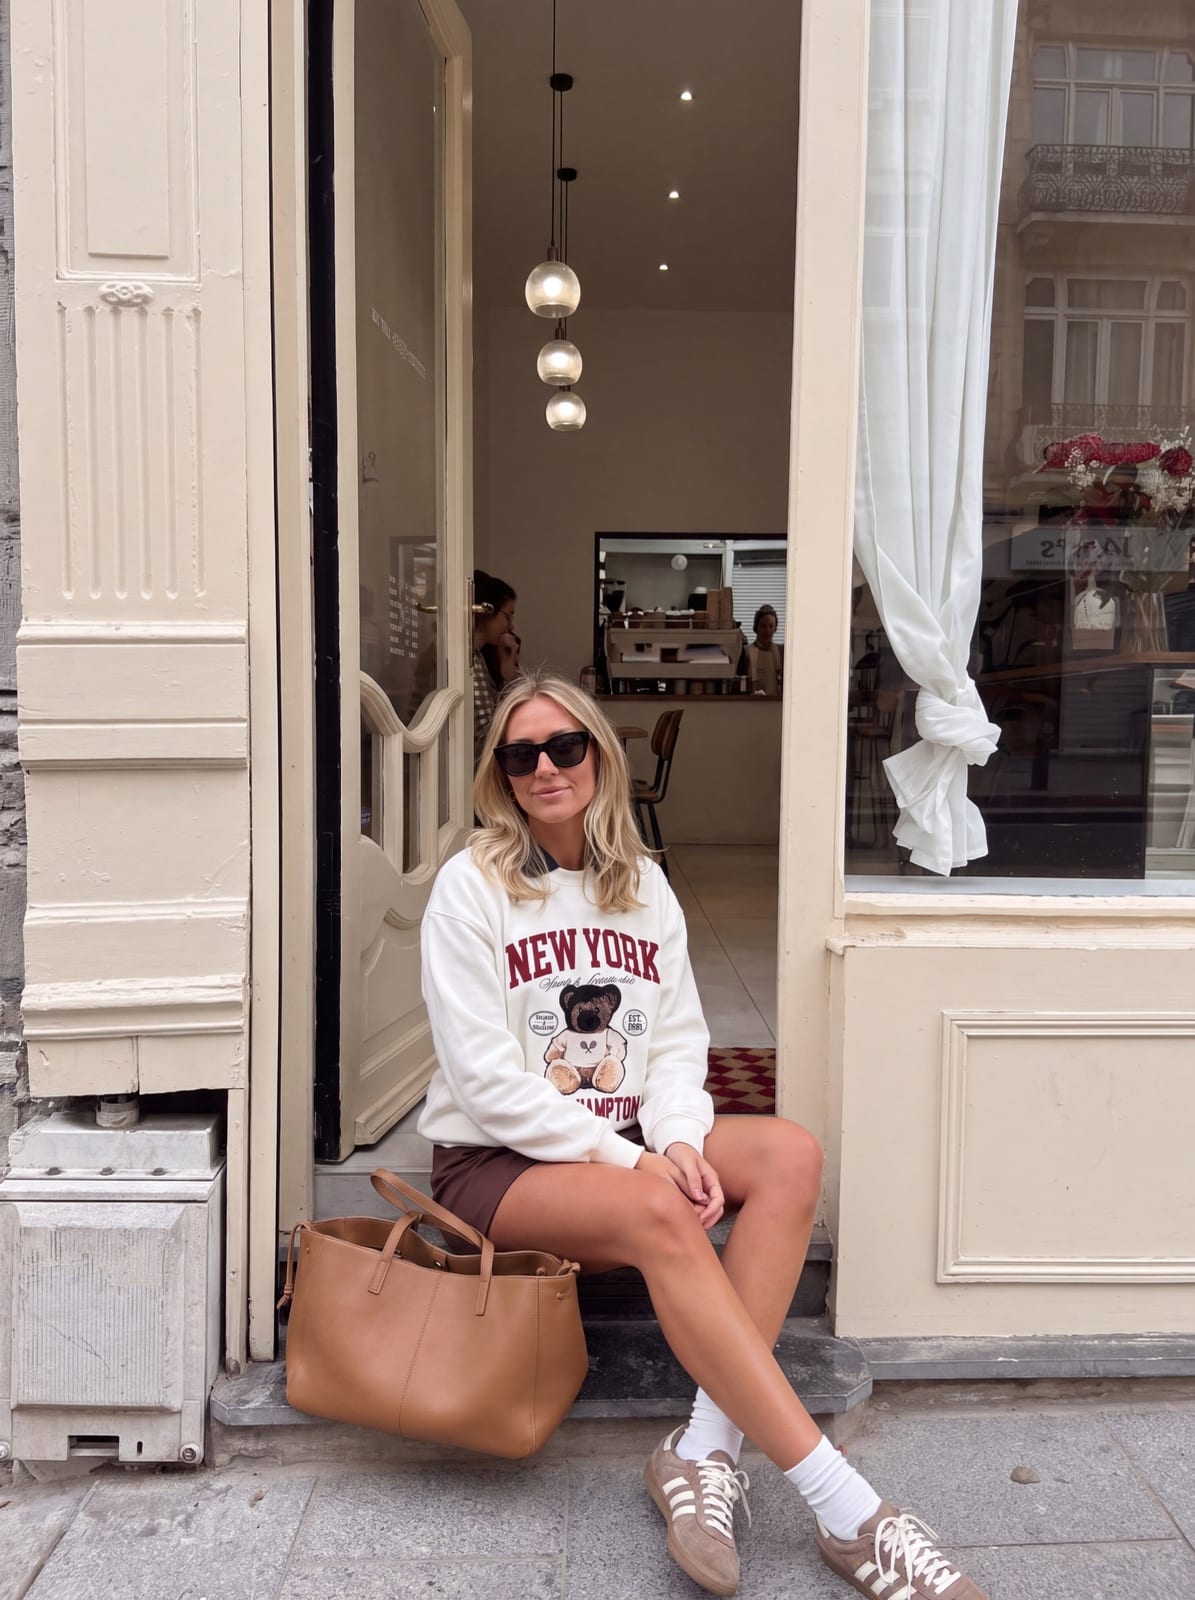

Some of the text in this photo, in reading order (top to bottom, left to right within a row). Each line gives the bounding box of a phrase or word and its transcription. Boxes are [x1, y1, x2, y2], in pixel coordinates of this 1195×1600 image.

[505, 928, 661, 989] NEW YORK
[628, 1014, 643, 1022] EST.
[576, 1095, 640, 1121] AMPTON
